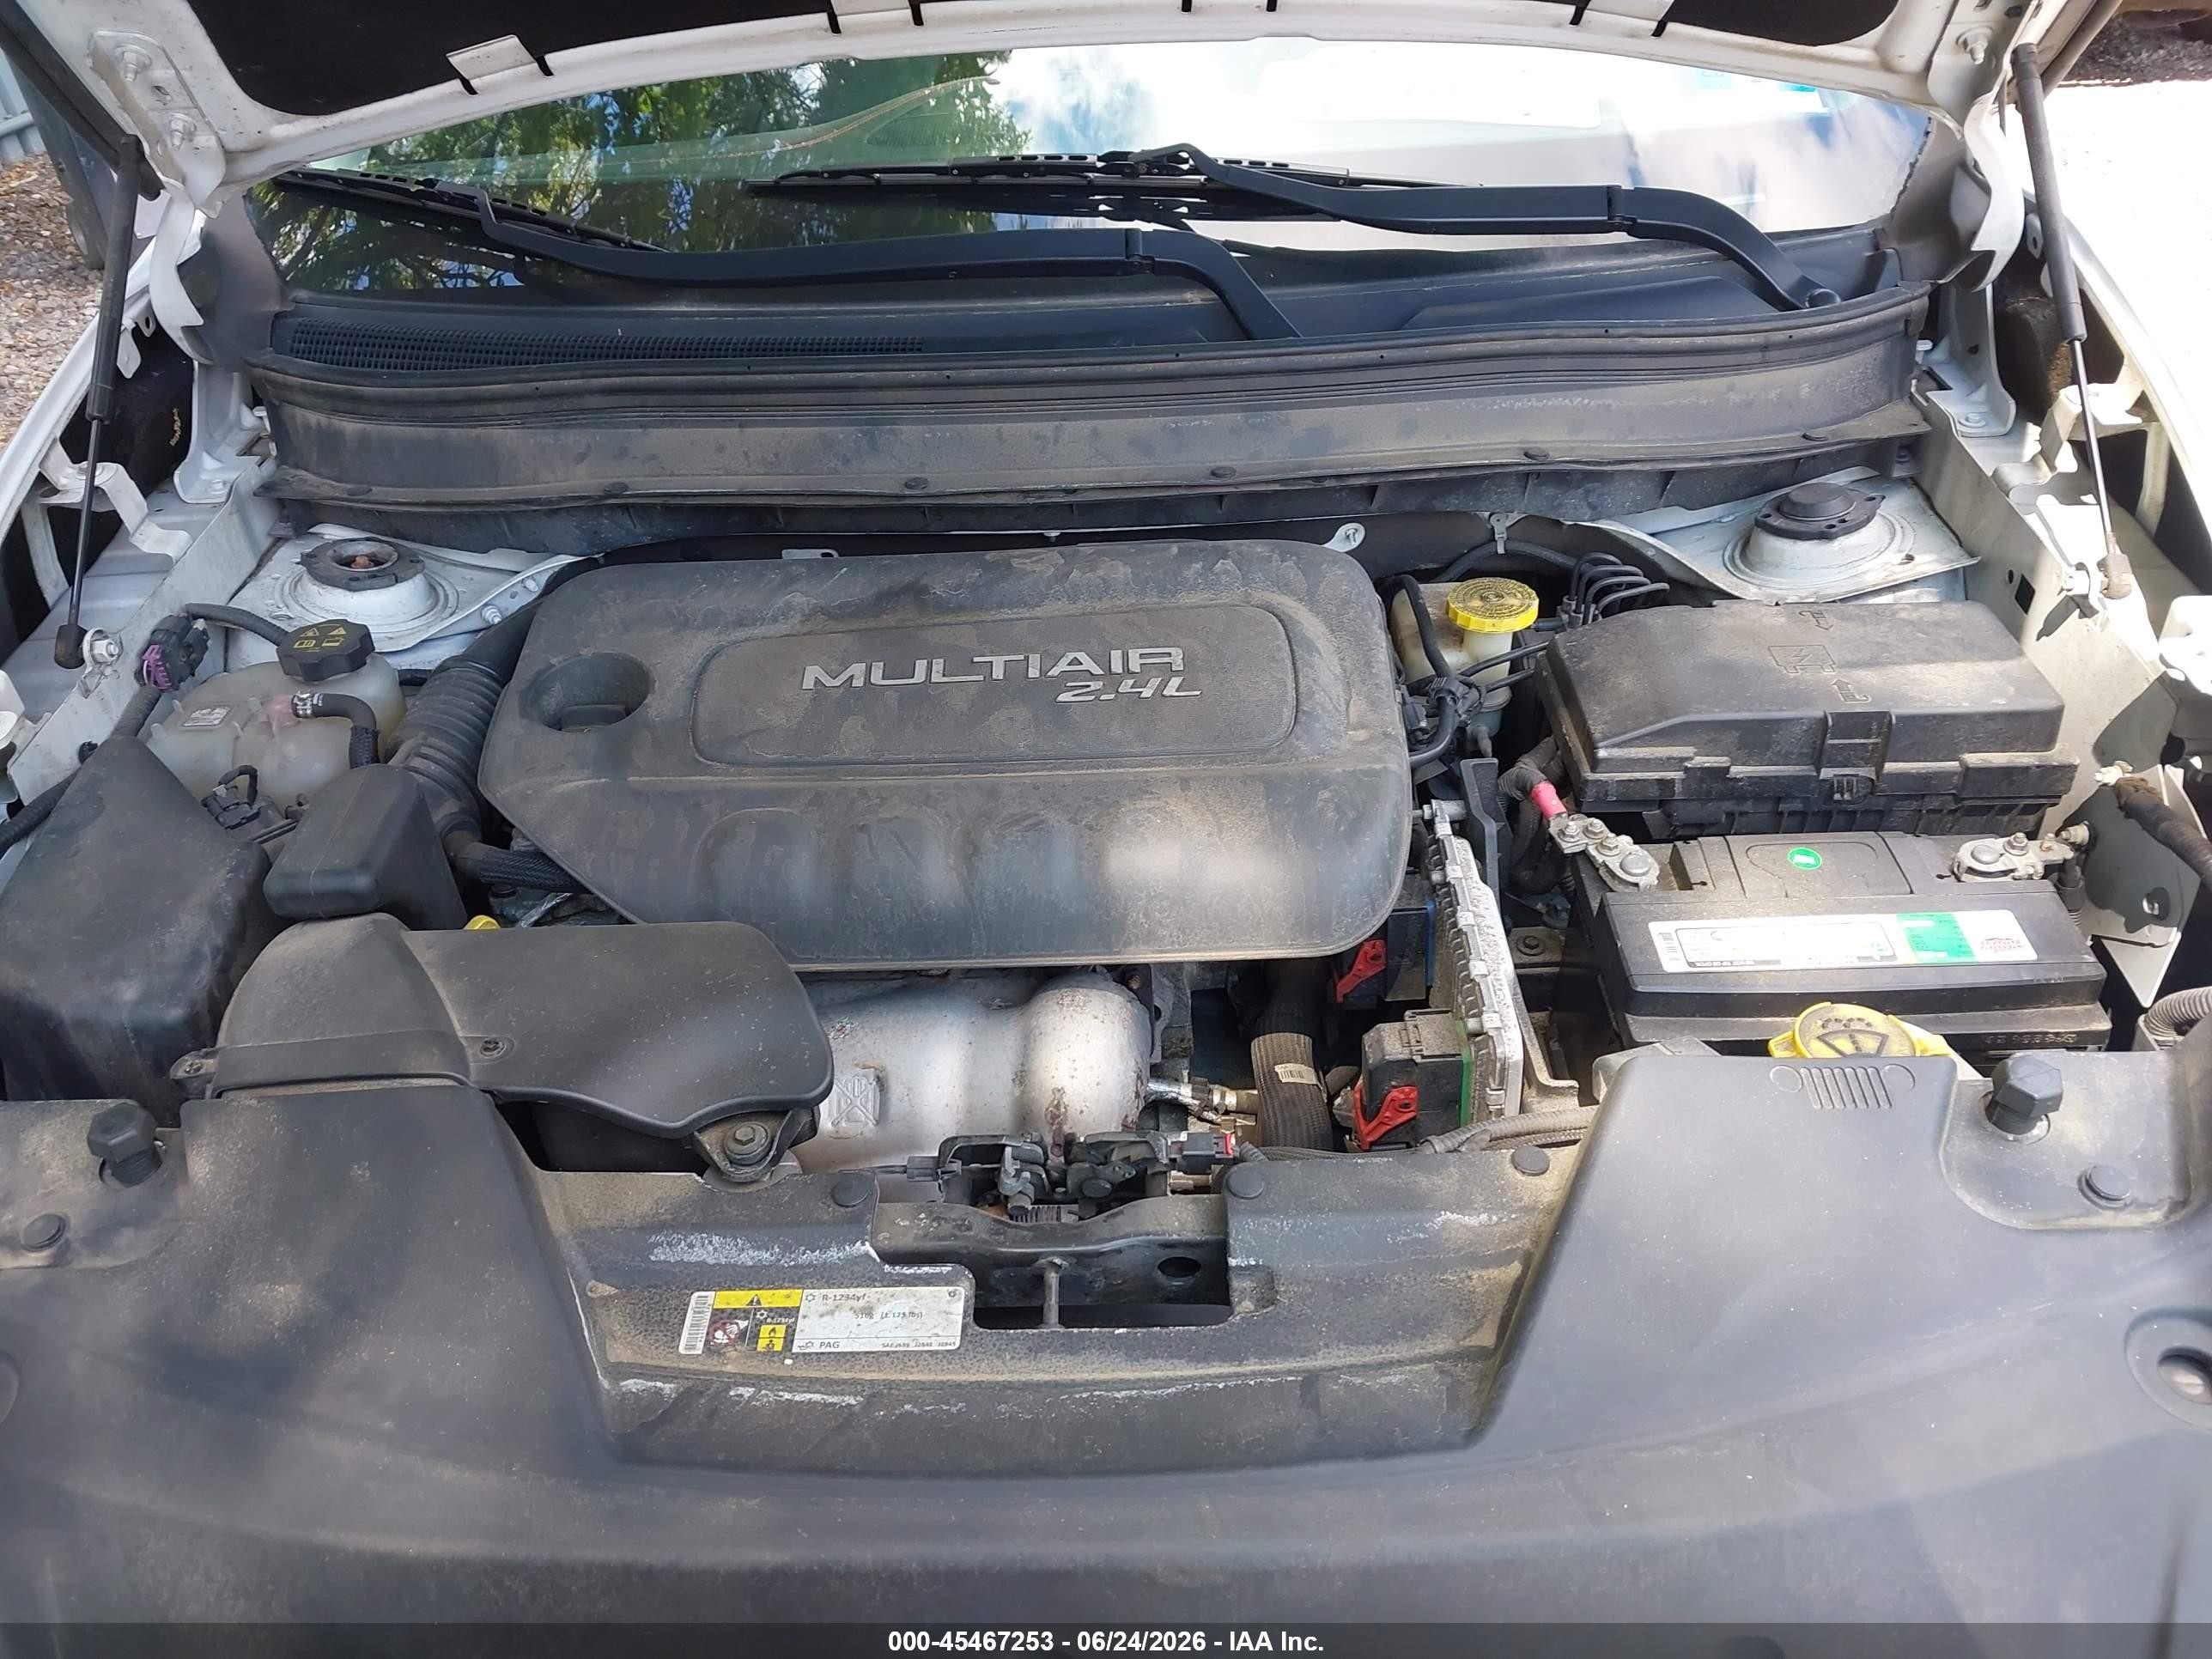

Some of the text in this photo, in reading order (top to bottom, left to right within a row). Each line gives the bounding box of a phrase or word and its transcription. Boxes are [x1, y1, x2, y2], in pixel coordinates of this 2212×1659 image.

[801, 647, 1185, 690] MULTIAIR
[1054, 676, 1203, 704] 2.4L
[822, 1292, 866, 1303] R-1234yf
[819, 1340, 841, 1349] PAG
